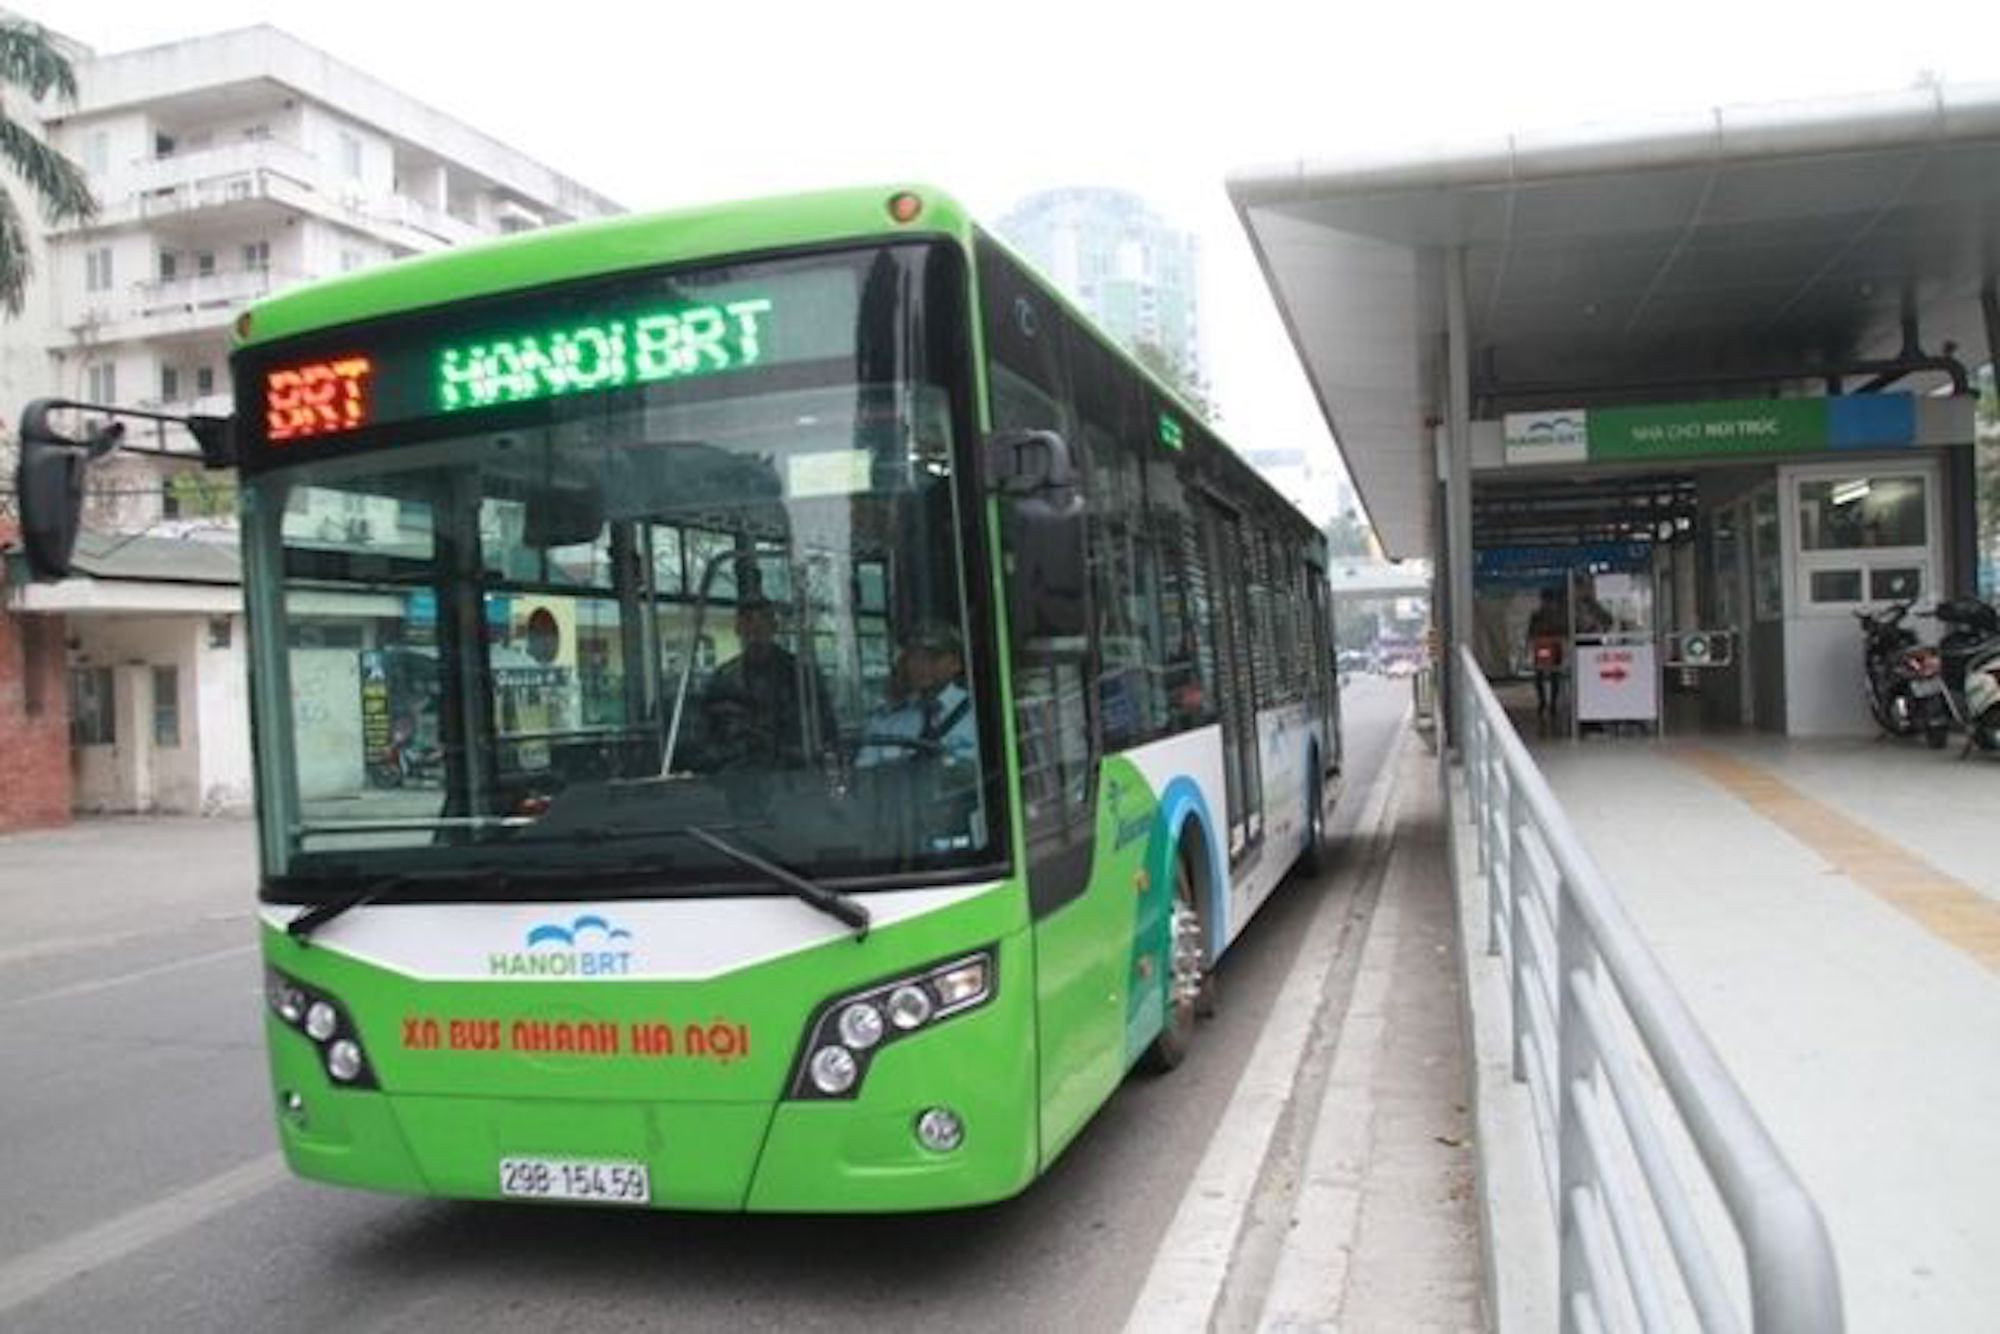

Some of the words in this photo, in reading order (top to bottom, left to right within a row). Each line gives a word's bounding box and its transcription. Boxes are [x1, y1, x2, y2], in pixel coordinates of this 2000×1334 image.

[442, 321, 627, 412] HANOI
[635, 298, 772, 380] BRT
[267, 357, 369, 440] BRT
[402, 1017, 440, 1050] XN
[449, 1018, 501, 1051] BUS
[512, 1019, 619, 1055] NHANH
